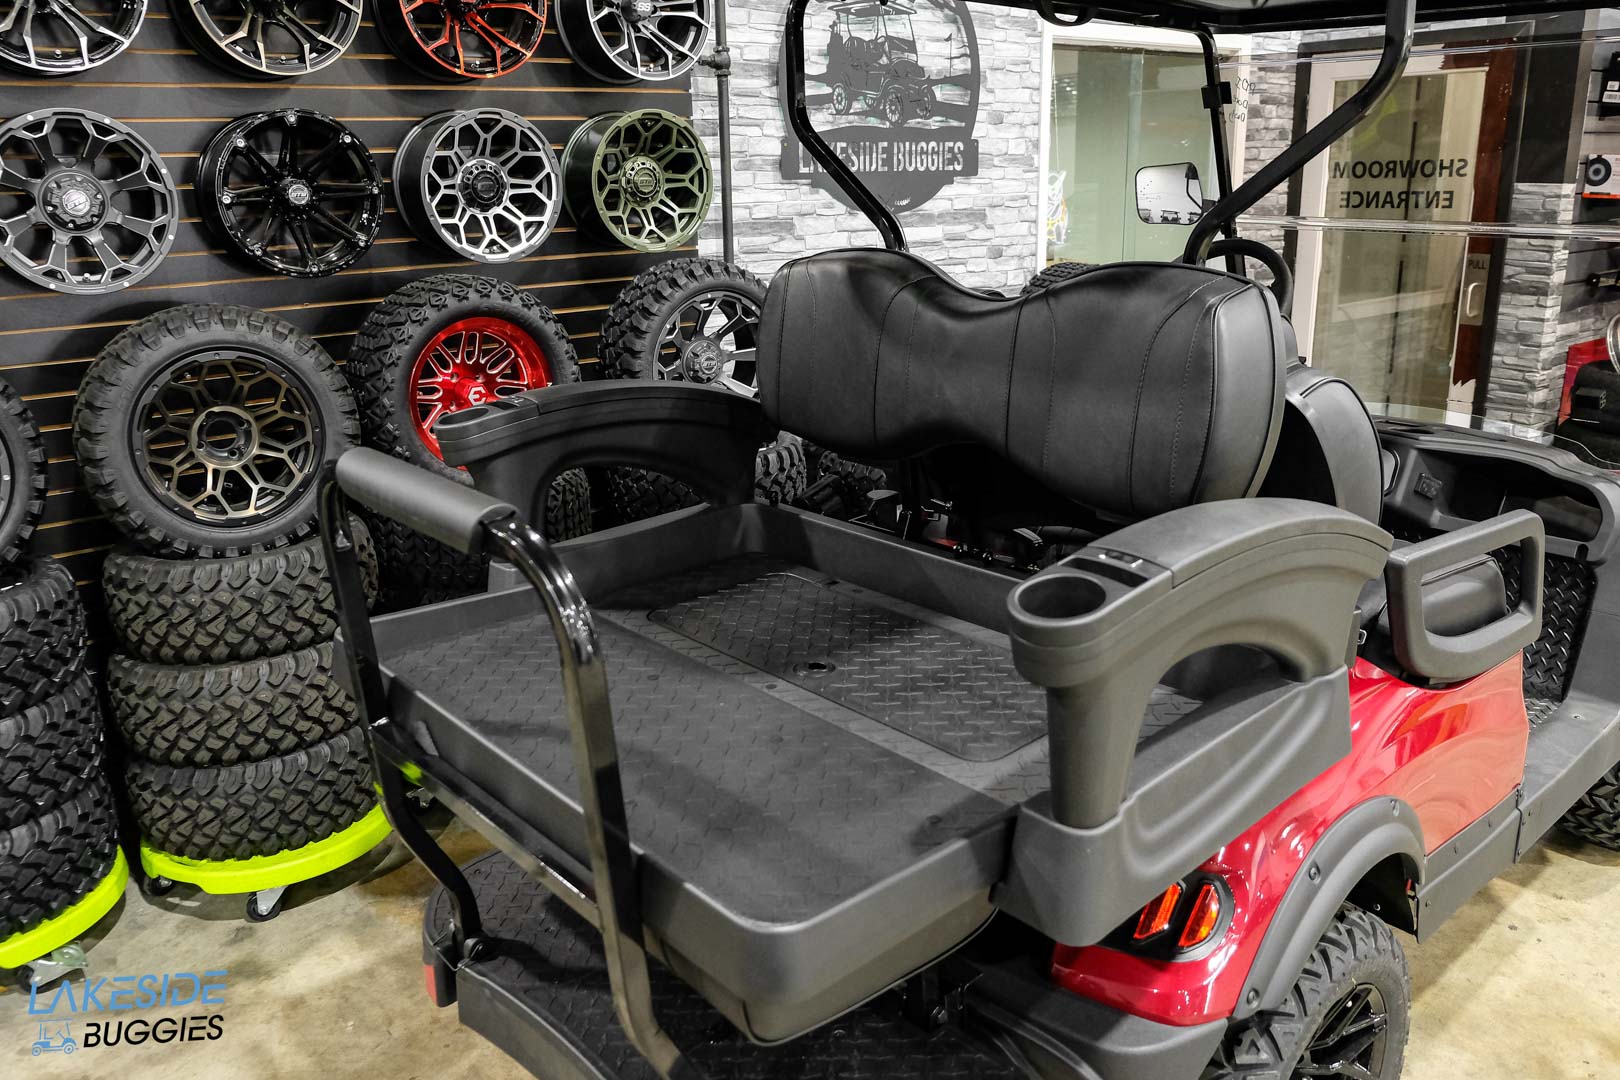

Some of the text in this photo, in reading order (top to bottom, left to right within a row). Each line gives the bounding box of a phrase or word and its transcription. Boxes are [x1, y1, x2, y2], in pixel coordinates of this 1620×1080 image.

[798, 141, 964, 174] LESIDE BUGGIES
[1468, 259, 1488, 270] PULL
